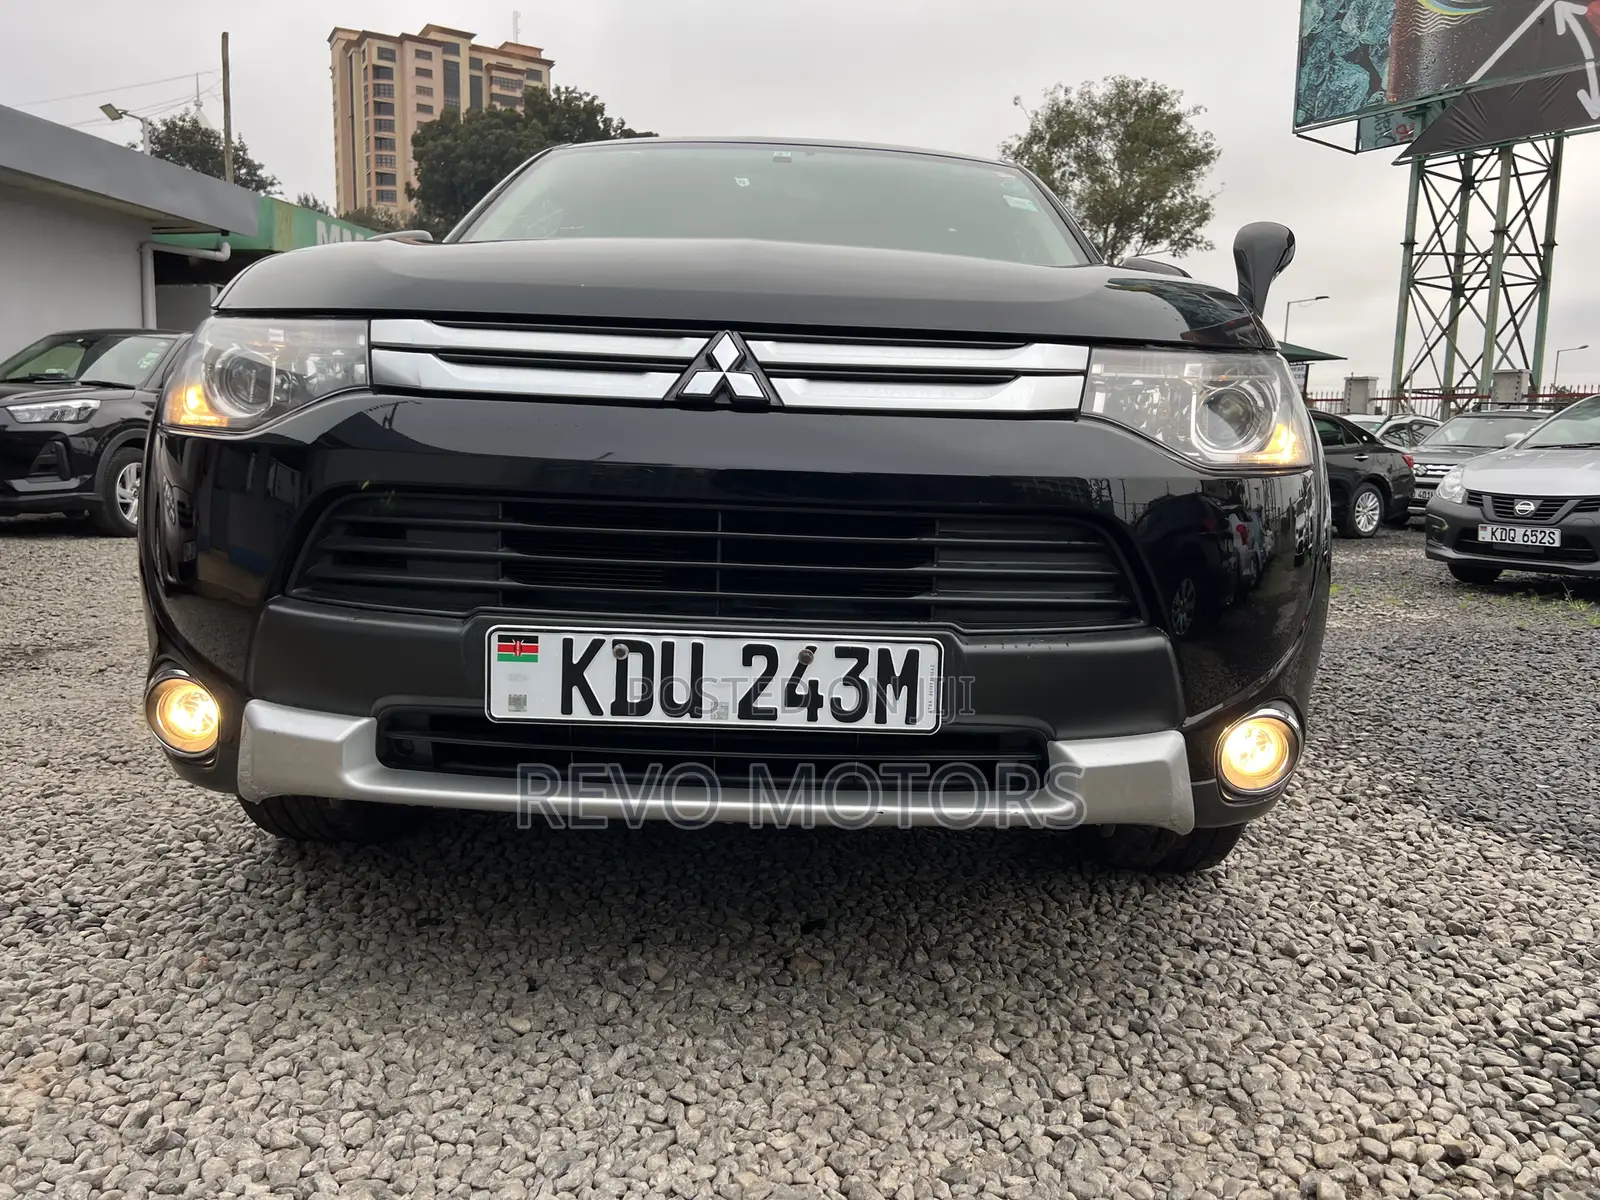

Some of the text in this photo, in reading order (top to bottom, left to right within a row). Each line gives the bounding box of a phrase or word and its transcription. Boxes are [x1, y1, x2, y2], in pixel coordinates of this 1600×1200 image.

[1491, 527, 1556, 545] KDQ 652S
[560, 637, 704, 719] KDU
[737, 642, 921, 726] 243M
